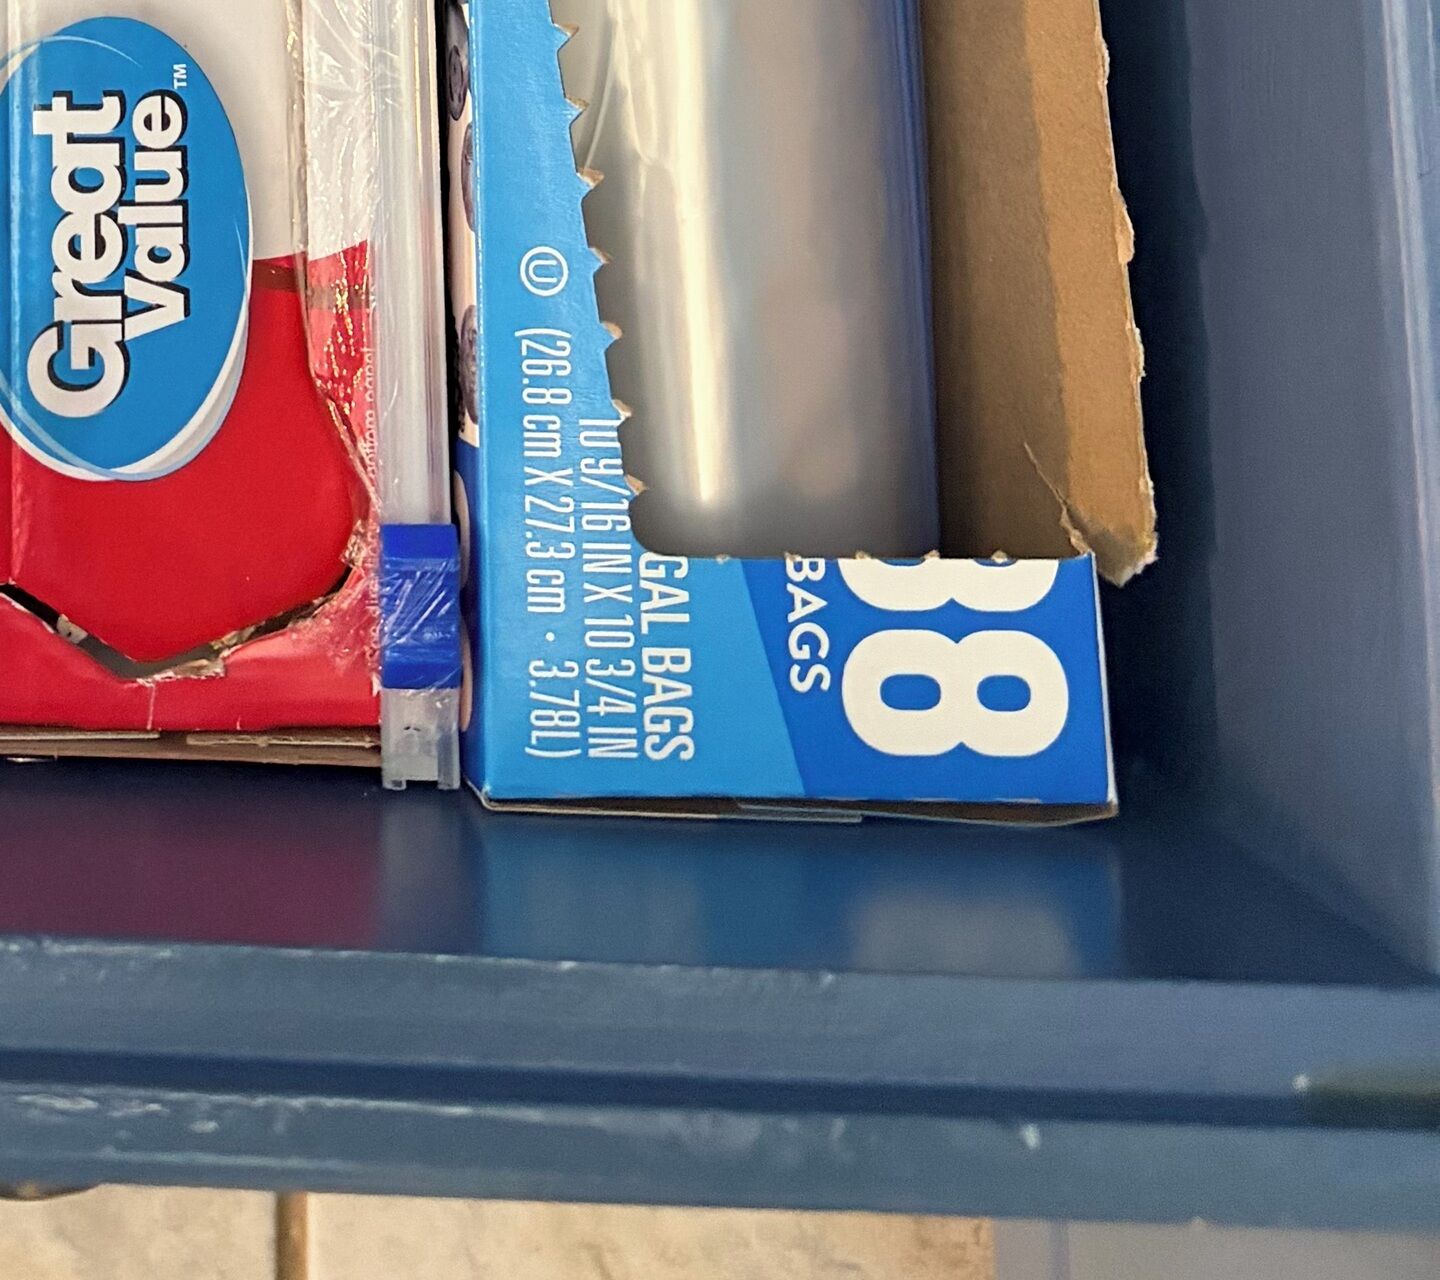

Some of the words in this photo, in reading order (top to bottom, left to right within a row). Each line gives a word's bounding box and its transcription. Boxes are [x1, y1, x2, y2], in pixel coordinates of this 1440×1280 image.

[26, 91, 128, 418] Great
[515, 327, 572, 404] (26.8
[522, 414, 566, 456] cm
[522, 466, 574, 487] X
[579, 456, 632, 532] 9/16
[524, 496, 576, 559] 27.3
[582, 542, 633, 573] IN
[526, 568, 567, 614] cm
[584, 584, 634, 608] X
[638, 552, 691, 634] GAL
[584, 614, 635, 648] 10
[785, 555, 831, 694] BAGS
[524, 659, 582, 759] 3.78L)
[585, 659, 637, 716] 3/4
[640, 646, 695, 760] BAGS
[587, 726, 639, 757] IN
